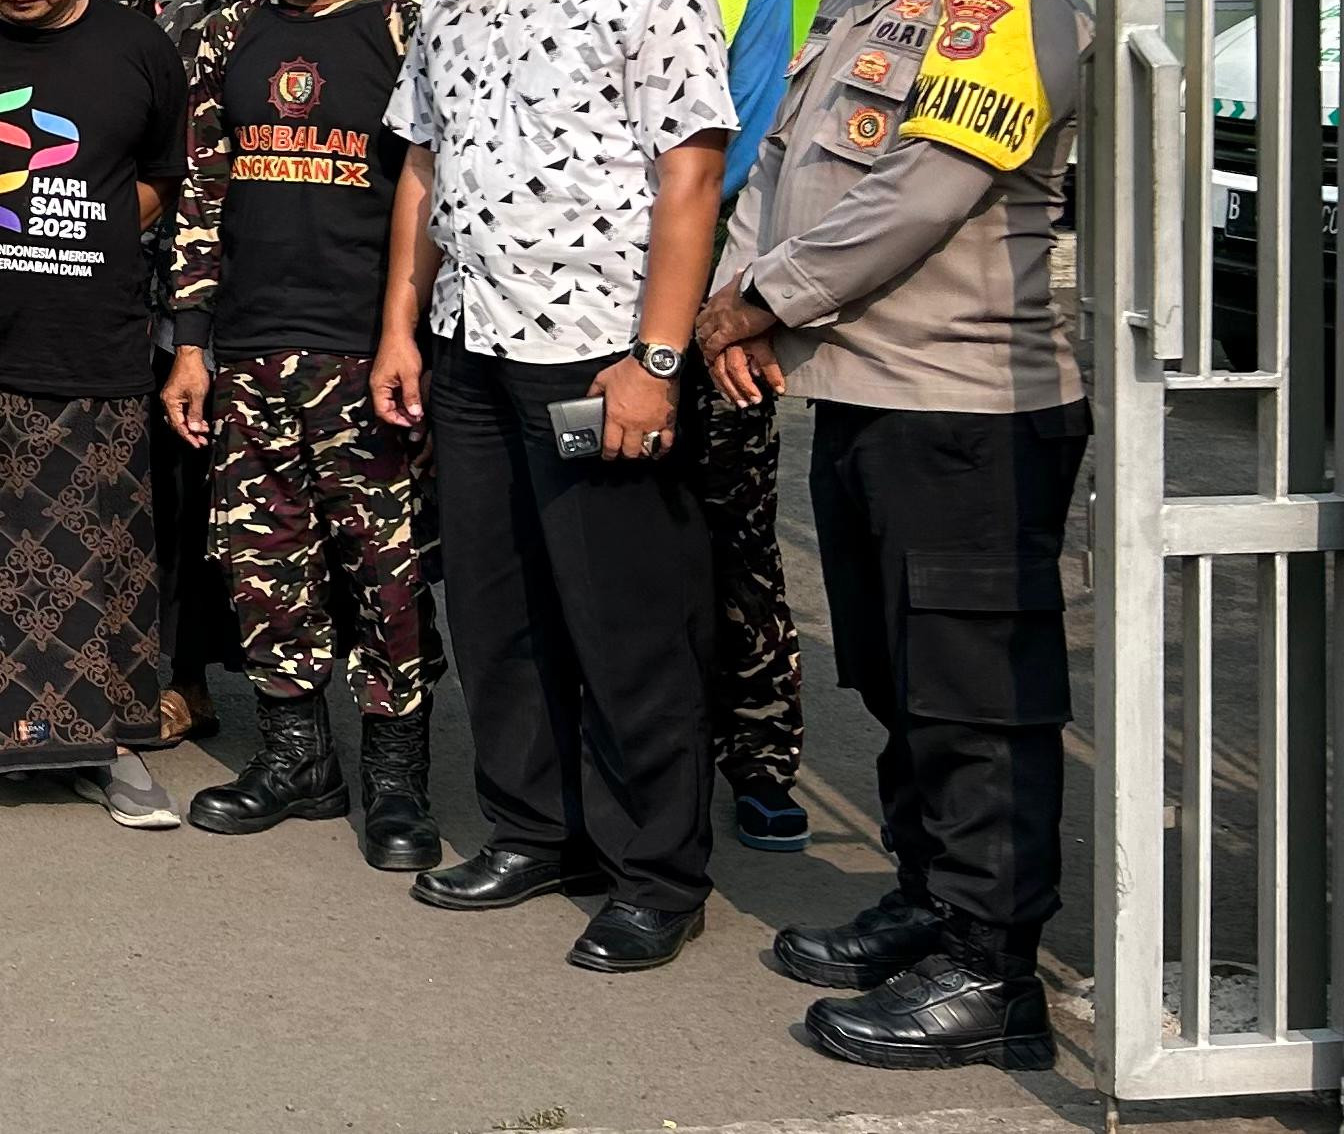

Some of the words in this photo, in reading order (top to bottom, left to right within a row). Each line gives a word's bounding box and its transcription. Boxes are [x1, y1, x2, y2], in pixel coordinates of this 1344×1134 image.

[876, 20, 927, 48] OLRI
[230, 155, 333, 184] ANGKATAN
[334, 160, 371, 188] X
[32, 177, 87, 198] HARI
[30, 197, 107, 221] SANTRI
[1229, 192, 1240, 220] B
[28, 217, 87, 240] 2025
[59, 249, 105, 264] MERDEKA
[60, 265, 93, 277] DUNIA
